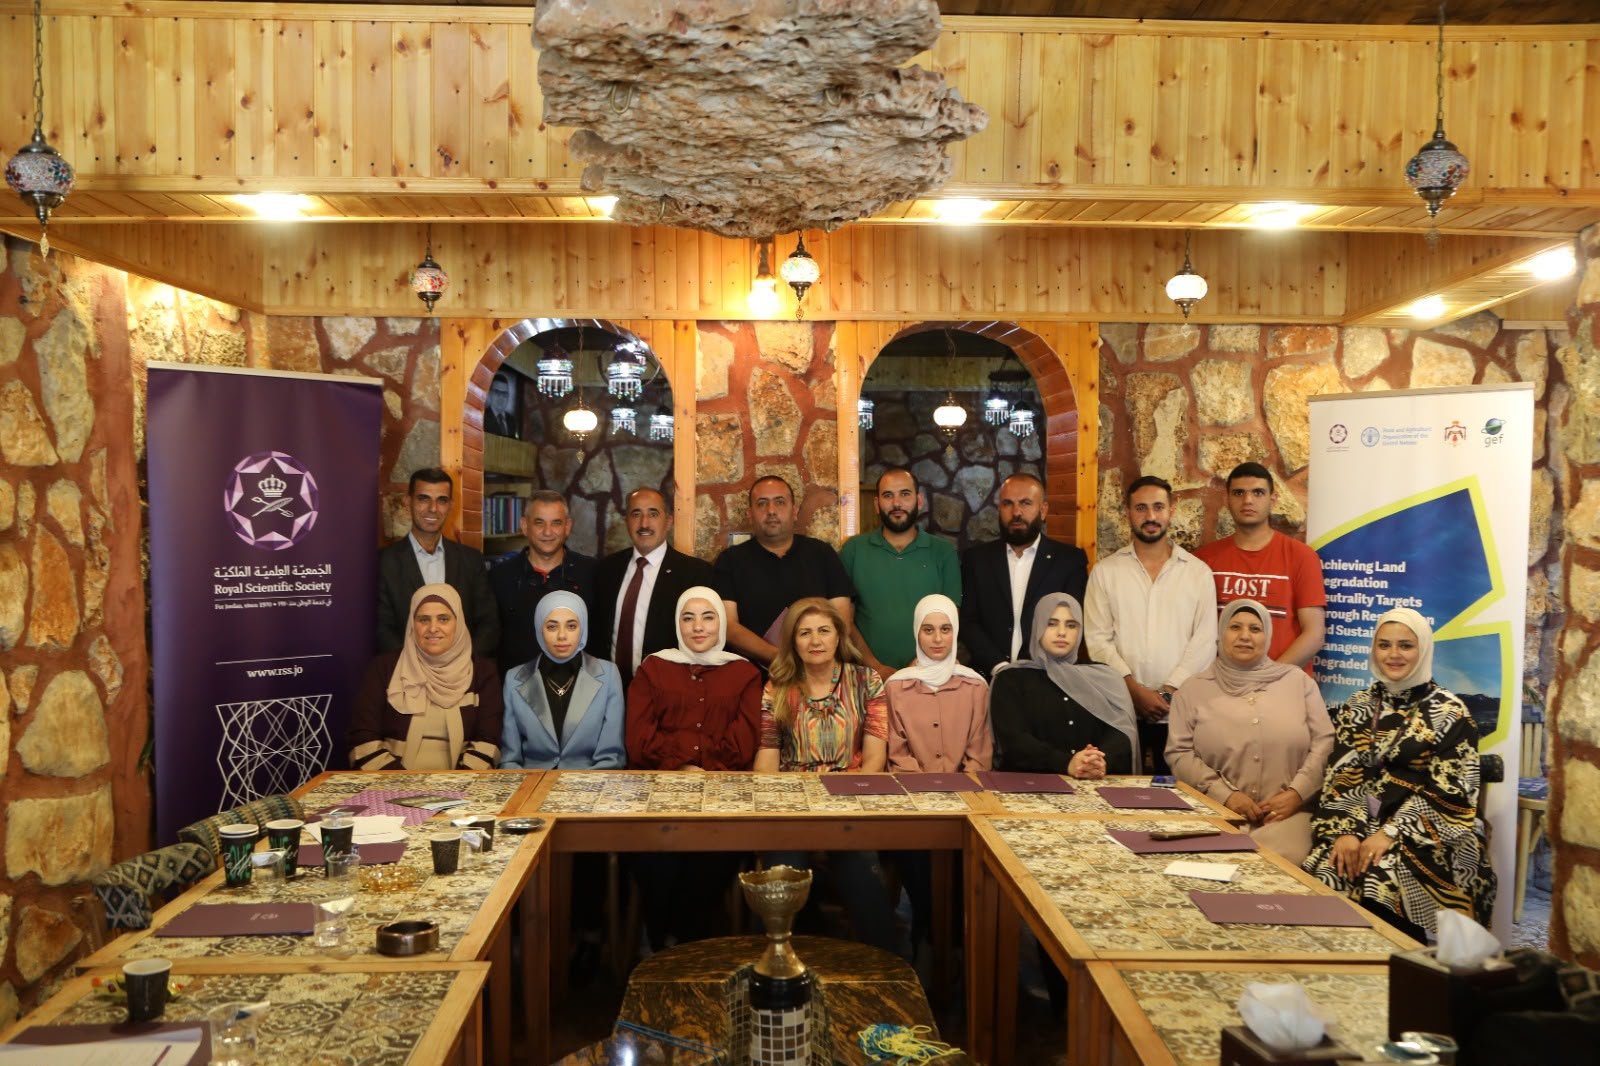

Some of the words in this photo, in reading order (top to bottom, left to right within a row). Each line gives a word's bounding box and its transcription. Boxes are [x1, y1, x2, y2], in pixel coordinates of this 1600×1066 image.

[1484, 433, 1504, 448] gef
[1375, 561, 1406, 573] Land
[214, 584, 244, 597] Royal
[245, 581, 294, 594] Scientific
[294, 581, 332, 593] Society
[1222, 576, 1271, 598] LOST
[1323, 577, 1388, 589] egradation
[1326, 592, 1374, 607] eutrality
[1375, 594, 1422, 609] Targets
[1326, 609, 1360, 623] rough
[1335, 624, 1374, 637] Sustai
[1323, 642, 1373, 656] anagem
[1311, 655, 1368, 671] Degraded
[246, 665, 304, 678] www.rss.jo
